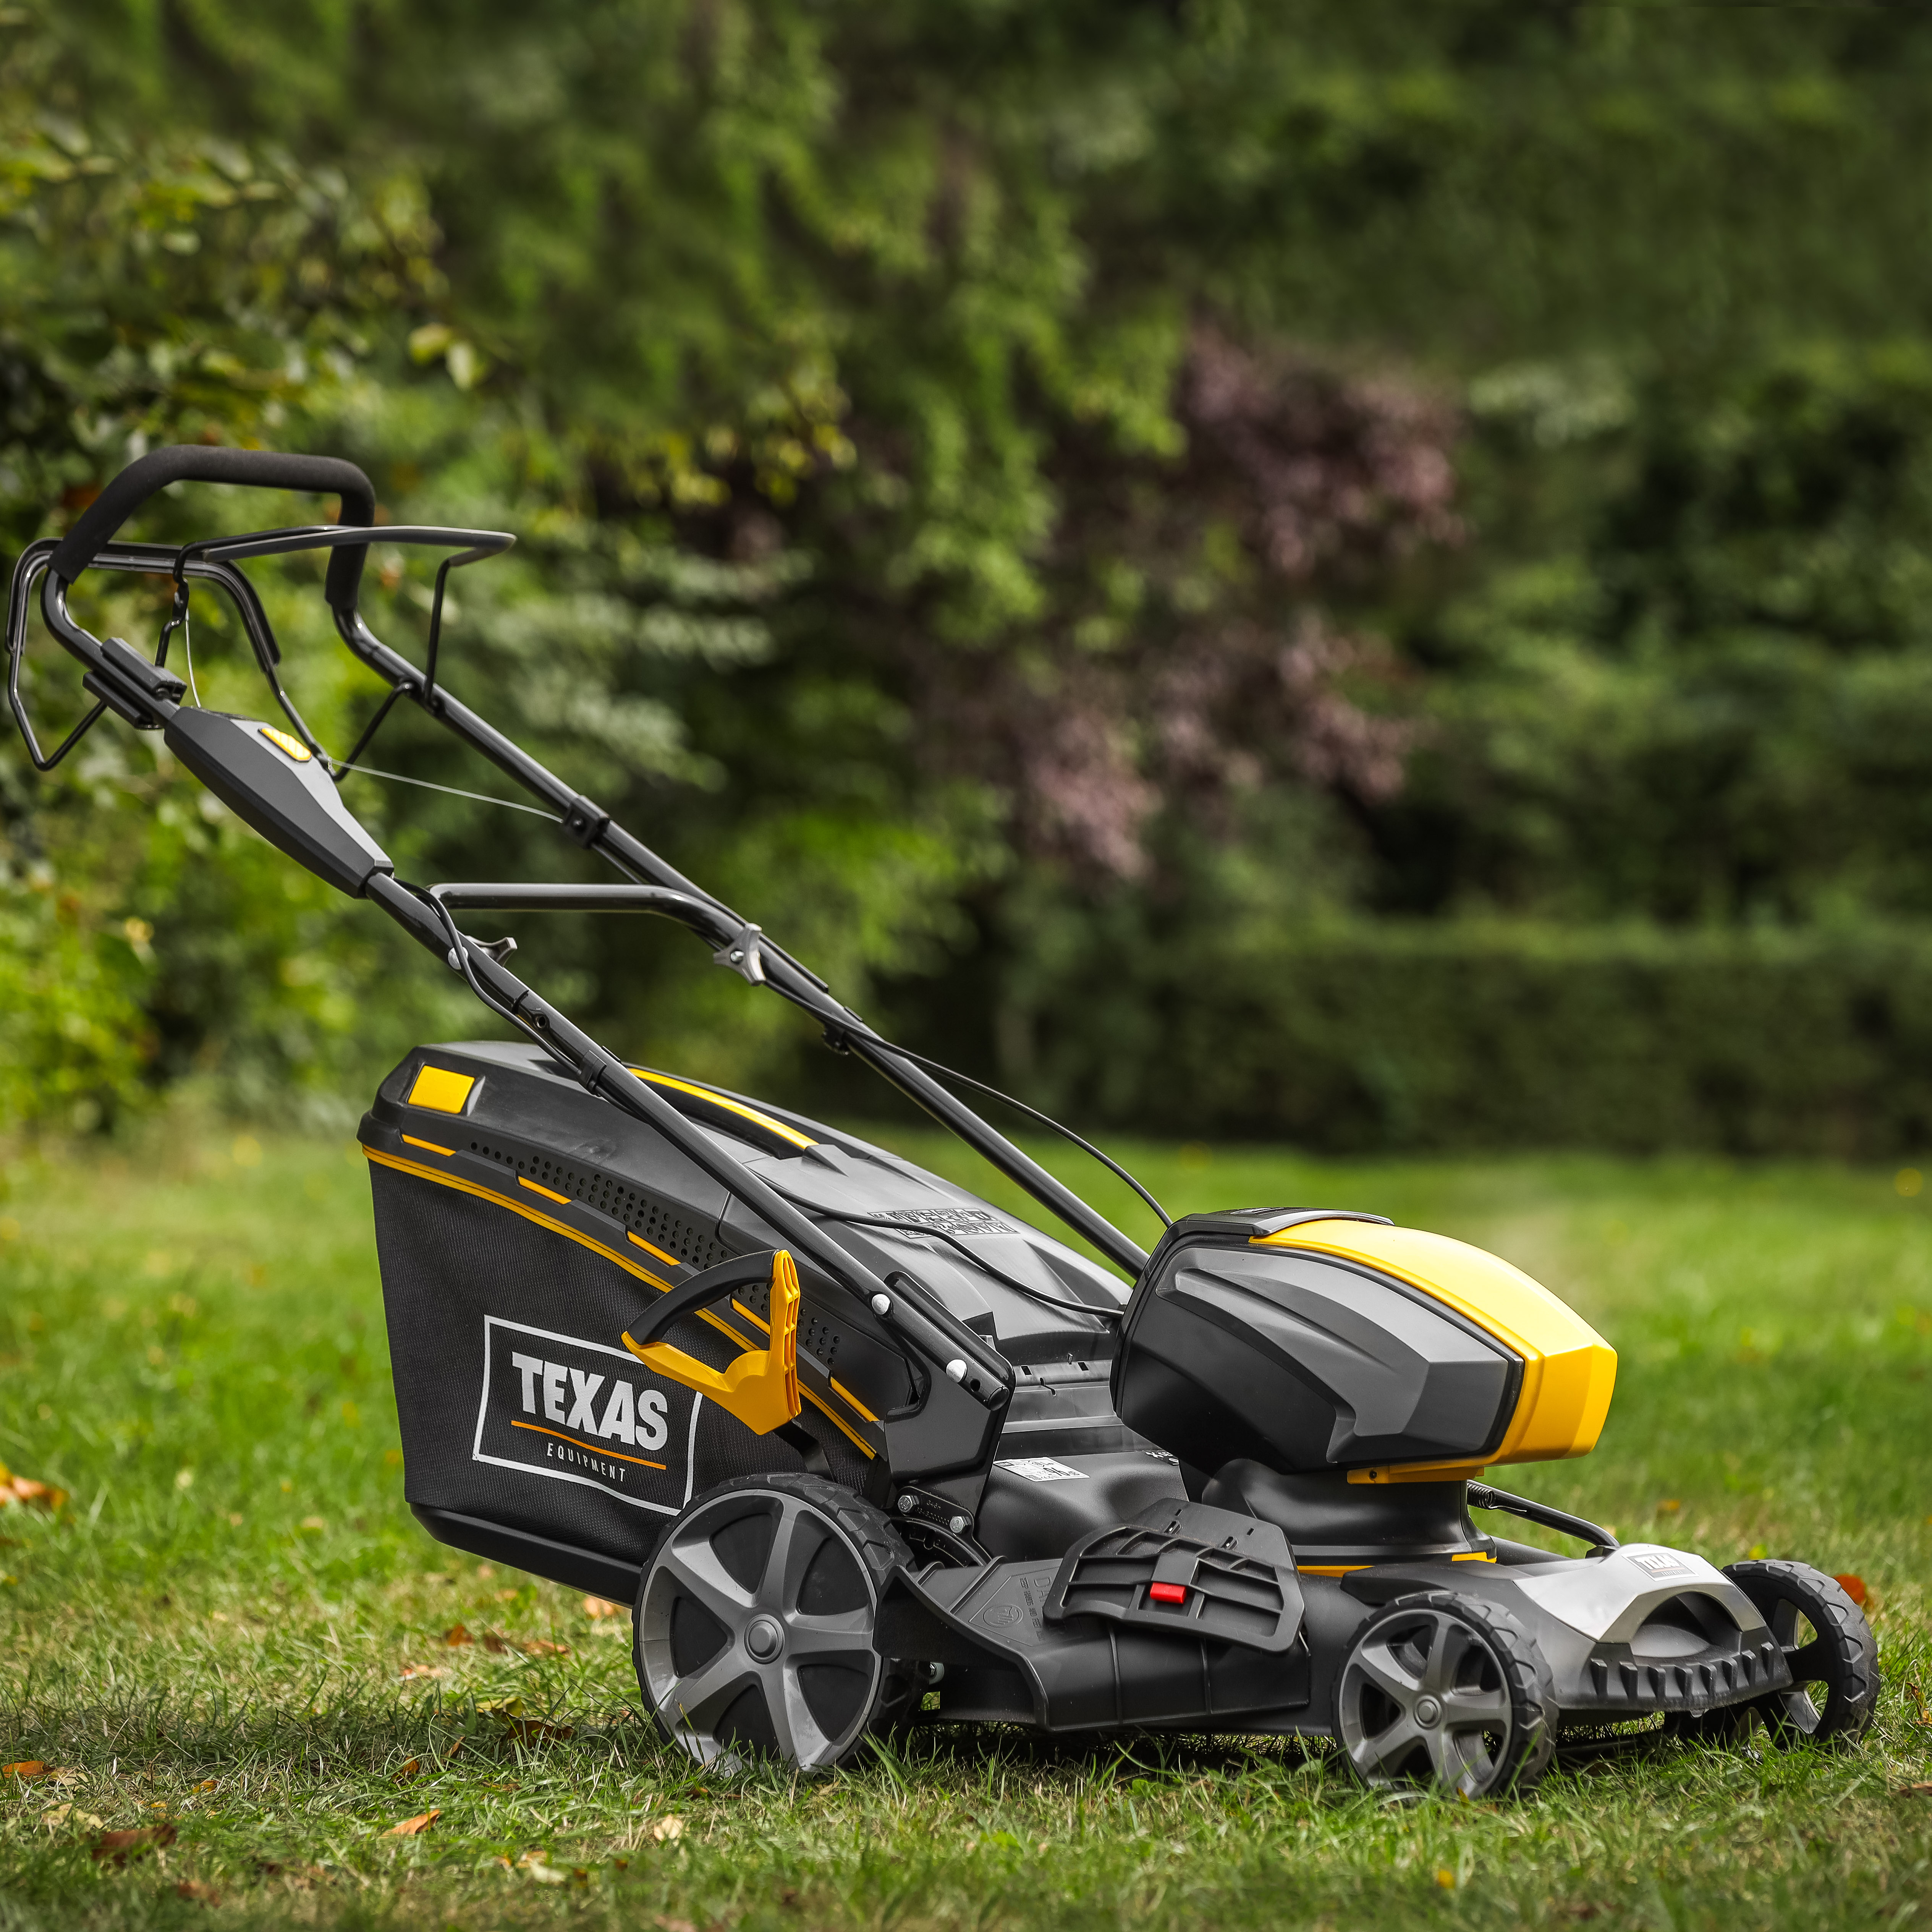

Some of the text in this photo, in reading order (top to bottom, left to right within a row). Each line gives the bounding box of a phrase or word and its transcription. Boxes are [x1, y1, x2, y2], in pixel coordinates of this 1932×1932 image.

[511, 1351, 668, 1451] TEXAS
[547, 1442, 626, 1482] EQUIPMENT
[1043, 1467, 1070, 1476] 96
[1634, 1555, 1681, 1570] TEXAS
[1023, 1590, 1034, 1606] HANDS
[1029, 1608, 1037, 1617] AND
